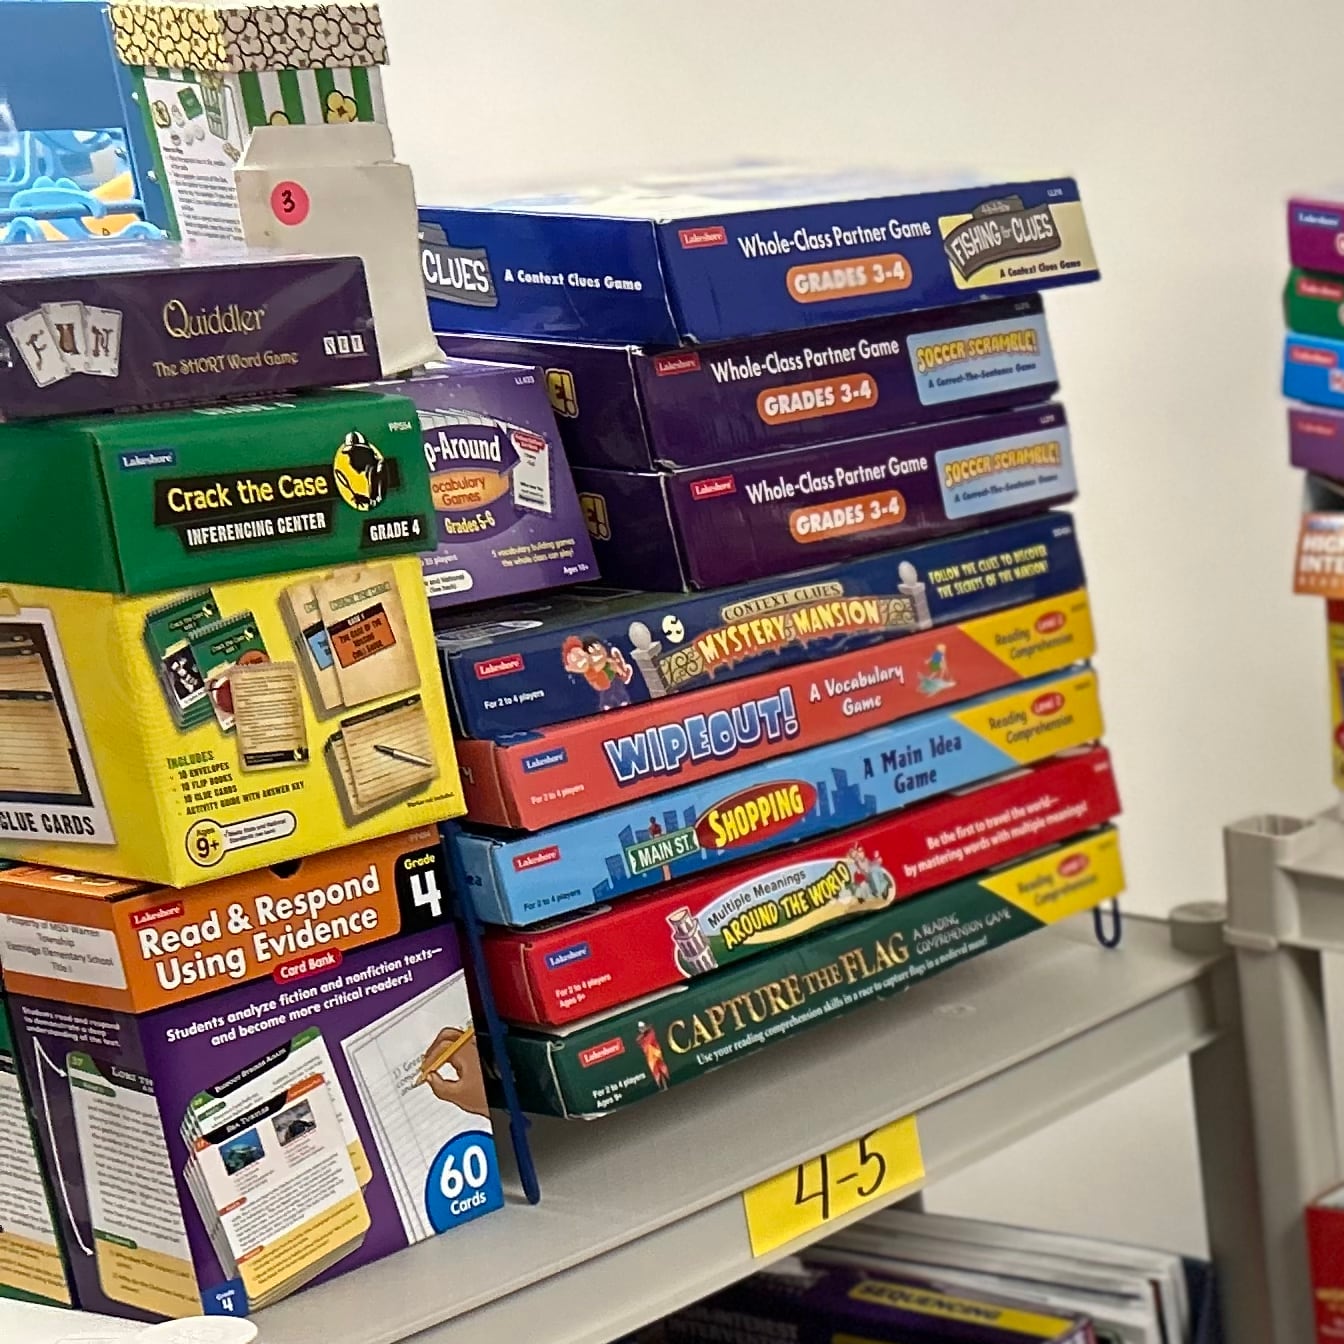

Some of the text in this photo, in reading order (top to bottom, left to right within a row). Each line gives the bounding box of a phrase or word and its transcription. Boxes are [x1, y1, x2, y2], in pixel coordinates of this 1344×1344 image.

[280, 190, 296, 213] 3
[737, 217, 932, 258] Whole-Class Partner Game
[422, 249, 490, 295] CLUES
[504, 269, 643, 291] A Context Clues Game
[794, 258, 906, 294] GRADES 3-4
[164, 299, 266, 338] Quiddler
[152, 350, 299, 377] The SHORT Word Game
[122, 454, 173, 468] Lakeshore
[167, 474, 328, 513] Crack the Case
[186, 512, 326, 546] INFERENCING CENTER
[368, 518, 422, 542] GRADE 4
[699, 599, 881, 664] MYSTERY MANSION
[604, 685, 799, 783] WIPEOUT!
[863, 734, 962, 779] A Main Idea
[894, 765, 937, 794] Game
[708, 782, 804, 849] SHOPPING
[404, 853, 437, 872] Grade
[139, 866, 381, 961] Read & Respond
[409, 874, 422, 919] 4
[721, 860, 852, 948] AROUND THE WORLD
[156, 904, 379, 993] Using Evidence
[211, 971, 414, 1047] and become more critical readers!
[667, 932, 910, 1054] CAPTURE THE FLAG
[439, 1145, 489, 1192] 60
[794, 1133, 887, 1220] 4-5
[449, 1191, 488, 1217] Cards
